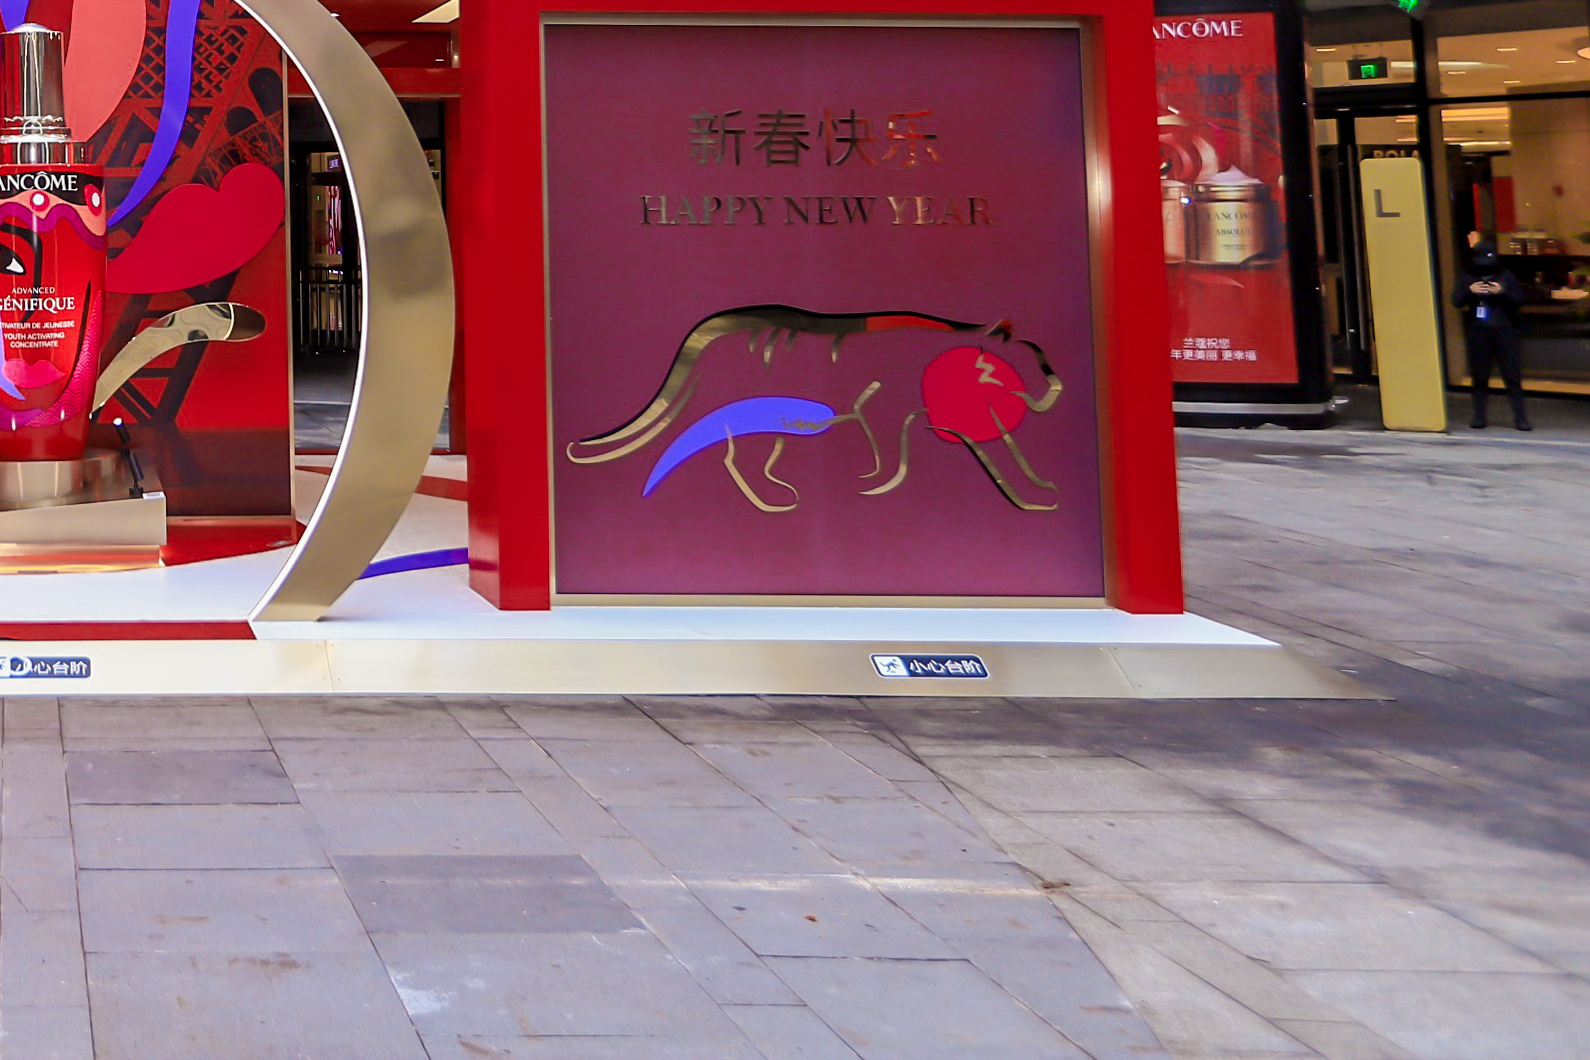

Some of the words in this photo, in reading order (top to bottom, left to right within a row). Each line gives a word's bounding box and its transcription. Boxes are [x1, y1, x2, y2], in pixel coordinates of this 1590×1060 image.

[687, 108, 940, 167] 新春快乐
[1374, 188, 1401, 218] L
[640, 195, 772, 225] HAPPY
[783, 195, 877, 225] NEW
[885, 195, 995, 226] YEAR
[11, 286, 56, 294] ADVANCED
[32, 321, 41, 329] DE
[42, 320, 75, 329] JEUNESSE
[3, 332, 26, 340] YOUTH
[27, 331, 65, 340] ACTIVATING
[10, 340, 59, 349] CONCENTRATE
[1182, 338, 1231, 349] 兰蔻祝您
[1221, 349, 1257, 361] 更幸福
[909, 658, 982, 675] 小心台阶
